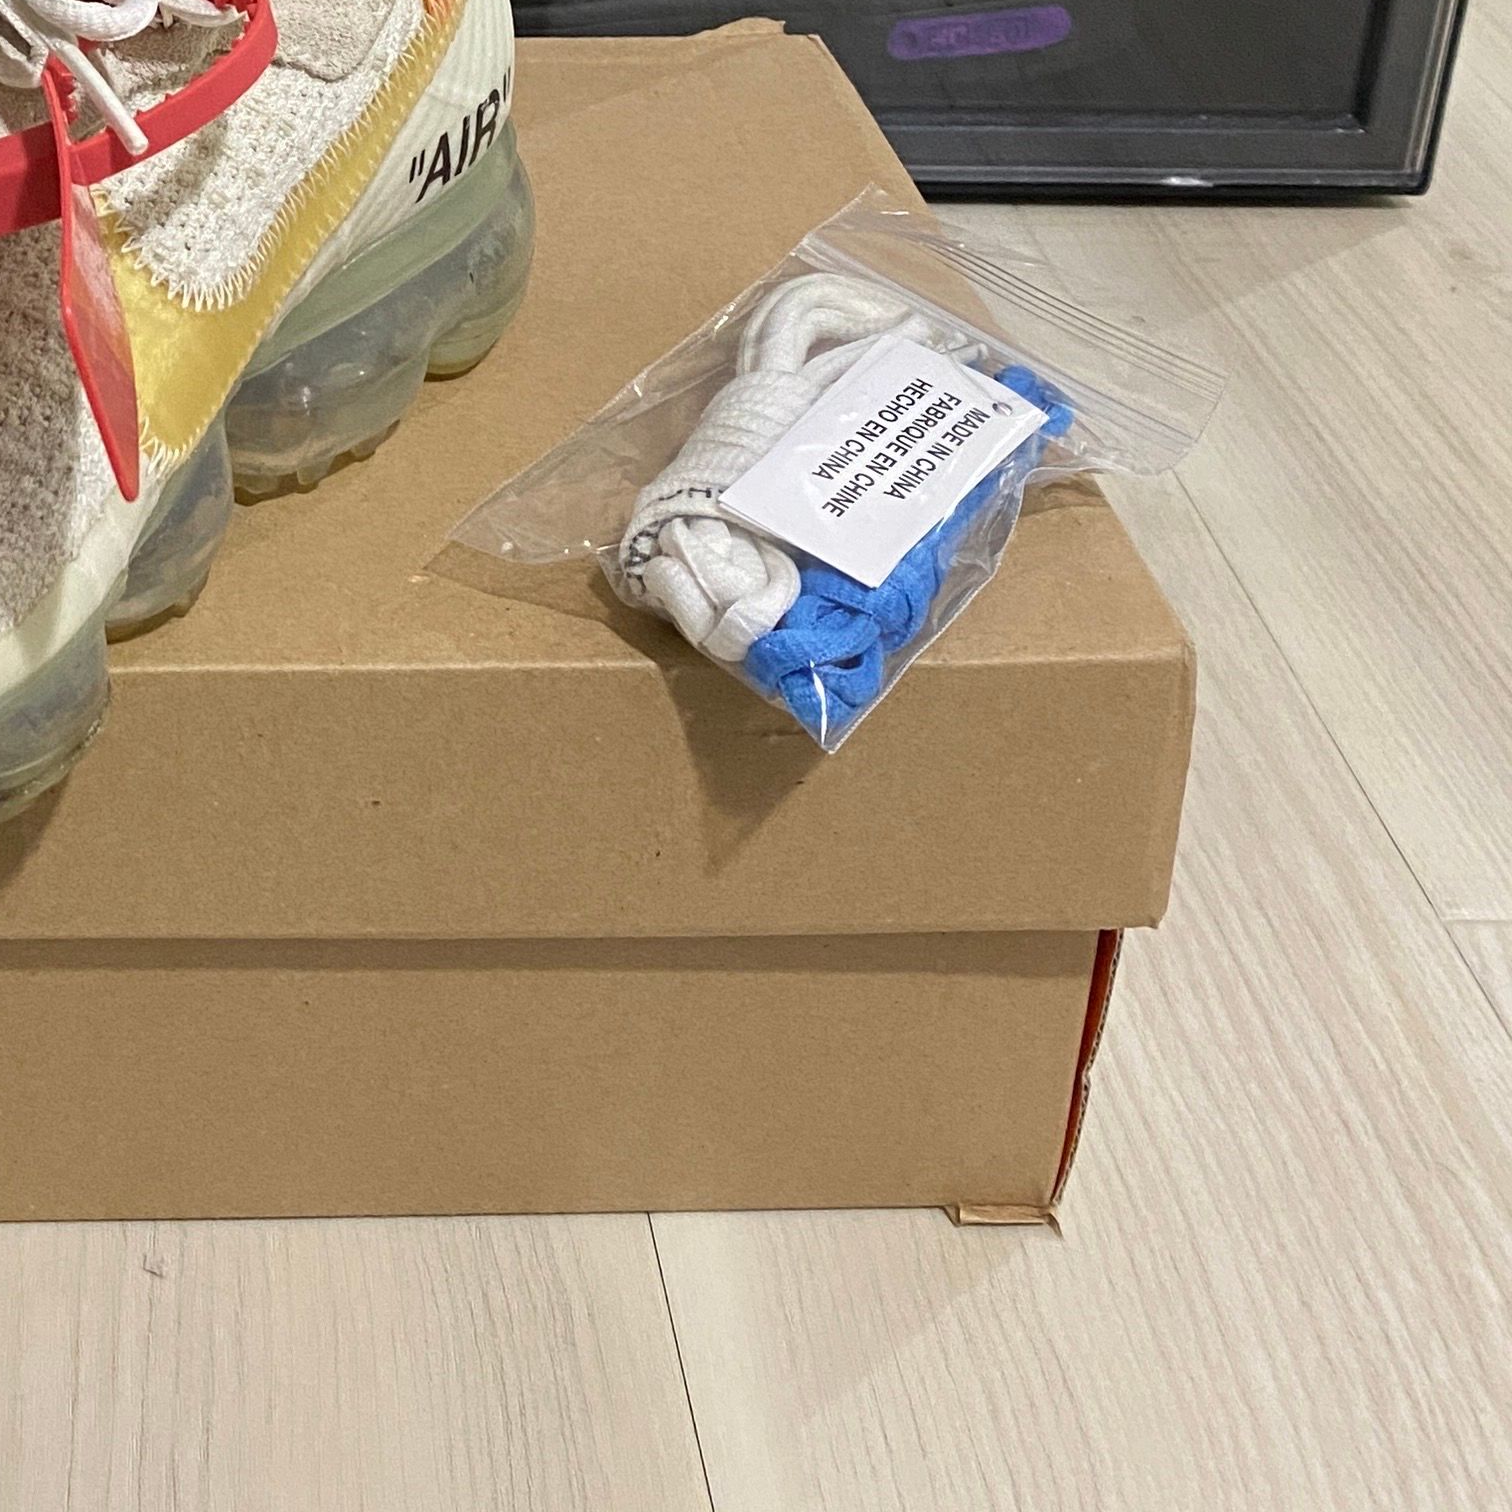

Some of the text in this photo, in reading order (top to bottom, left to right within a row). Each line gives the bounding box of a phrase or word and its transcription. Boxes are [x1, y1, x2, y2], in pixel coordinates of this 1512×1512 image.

[409, 66, 511, 203] "AIR"
[812, 378, 934, 480] HECHO EN CHINA
[821, 392, 962, 518] FABRIQUE EN CHINE
[883, 407, 991, 500] MADE IN CHINA
